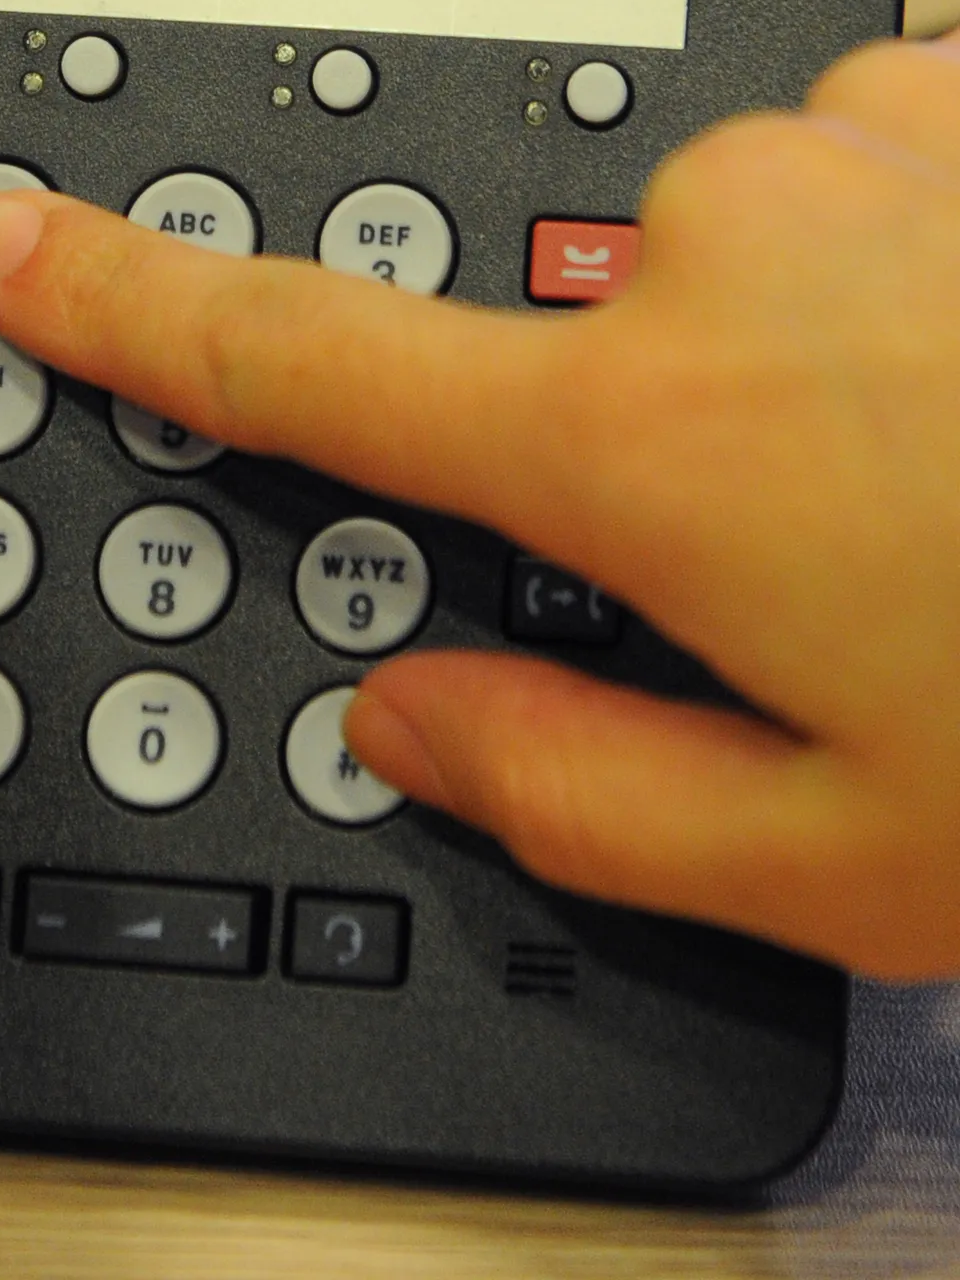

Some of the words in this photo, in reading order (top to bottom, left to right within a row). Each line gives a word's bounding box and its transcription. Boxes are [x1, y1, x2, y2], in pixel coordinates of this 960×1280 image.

[159, 211, 217, 236] ABC
[358, 222, 412, 249] DEF
[139, 541, 194, 568] TUV
[322, 554, 406, 584] WXYZ
[147, 580, 176, 616] 8
[348, 594, 375, 631] 9
[139, 727, 166, 765] 0
